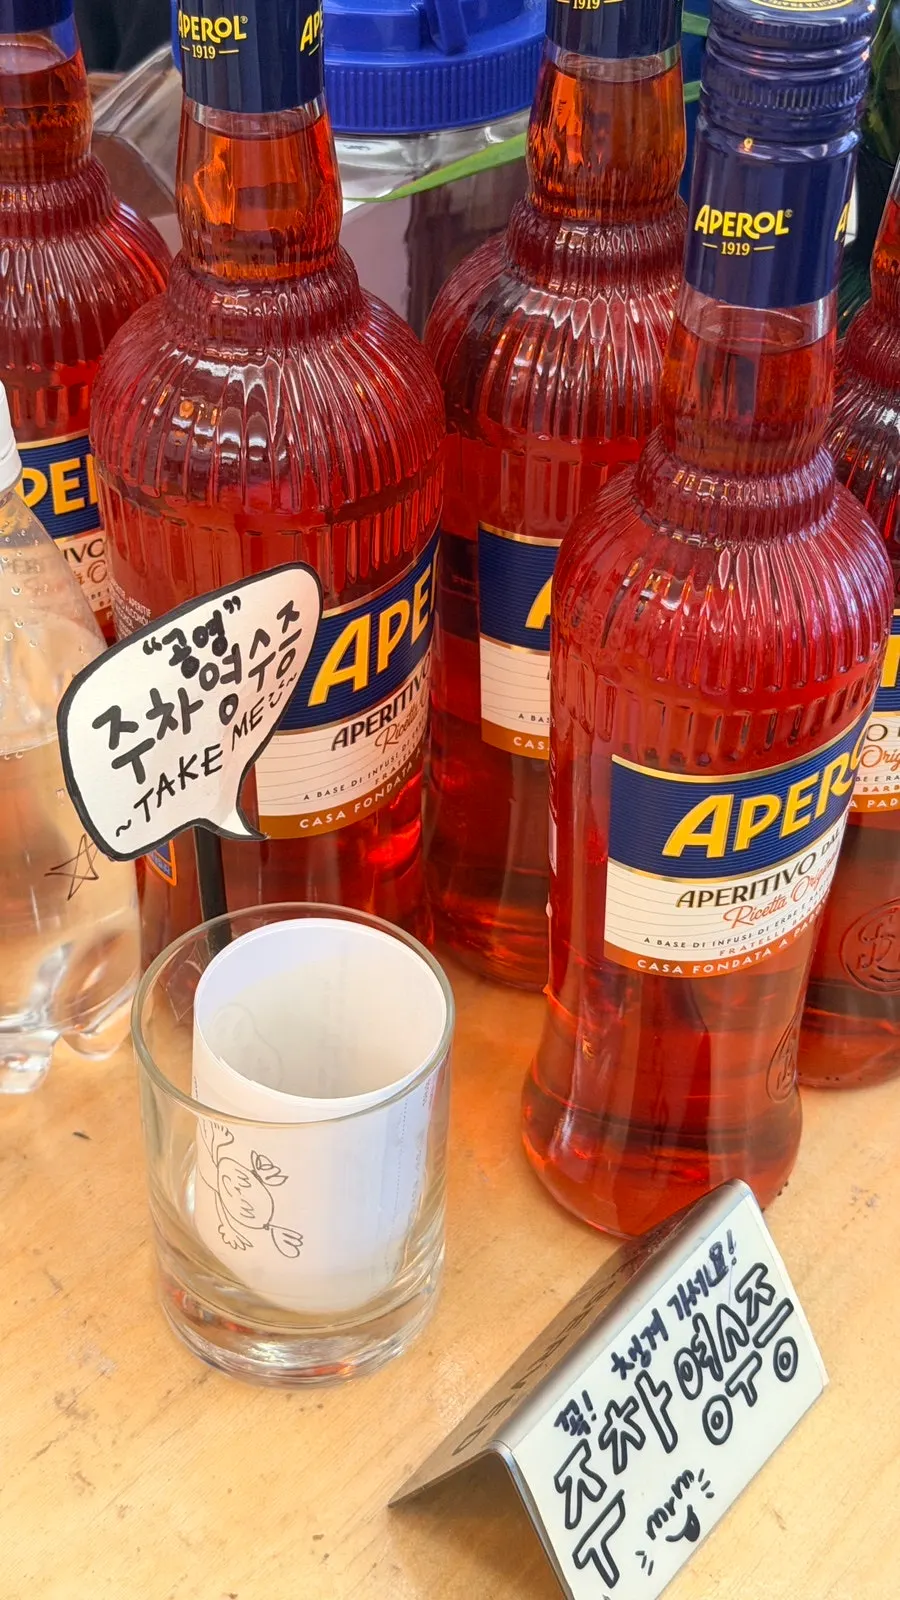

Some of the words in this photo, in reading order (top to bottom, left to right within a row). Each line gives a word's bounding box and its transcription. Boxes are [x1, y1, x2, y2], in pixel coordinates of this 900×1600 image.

[192, 44, 216, 59] 1919
[720, 241, 750, 256] 1919
[316, 784, 345, 798] BASE
[299, 810, 346, 829] CASA
[675, 852, 816, 910] APERITIVO
[722, 894, 788, 930] Ricetta
[656, 938, 688, 949] BASE
[692, 941, 707, 949] DI
[711, 932, 753, 949] INFUSI
[757, 925, 770, 936] DI
[637, 959, 684, 975] CASA
[691, 947, 773, 975] FONDATA
[778, 937, 789, 950] A
